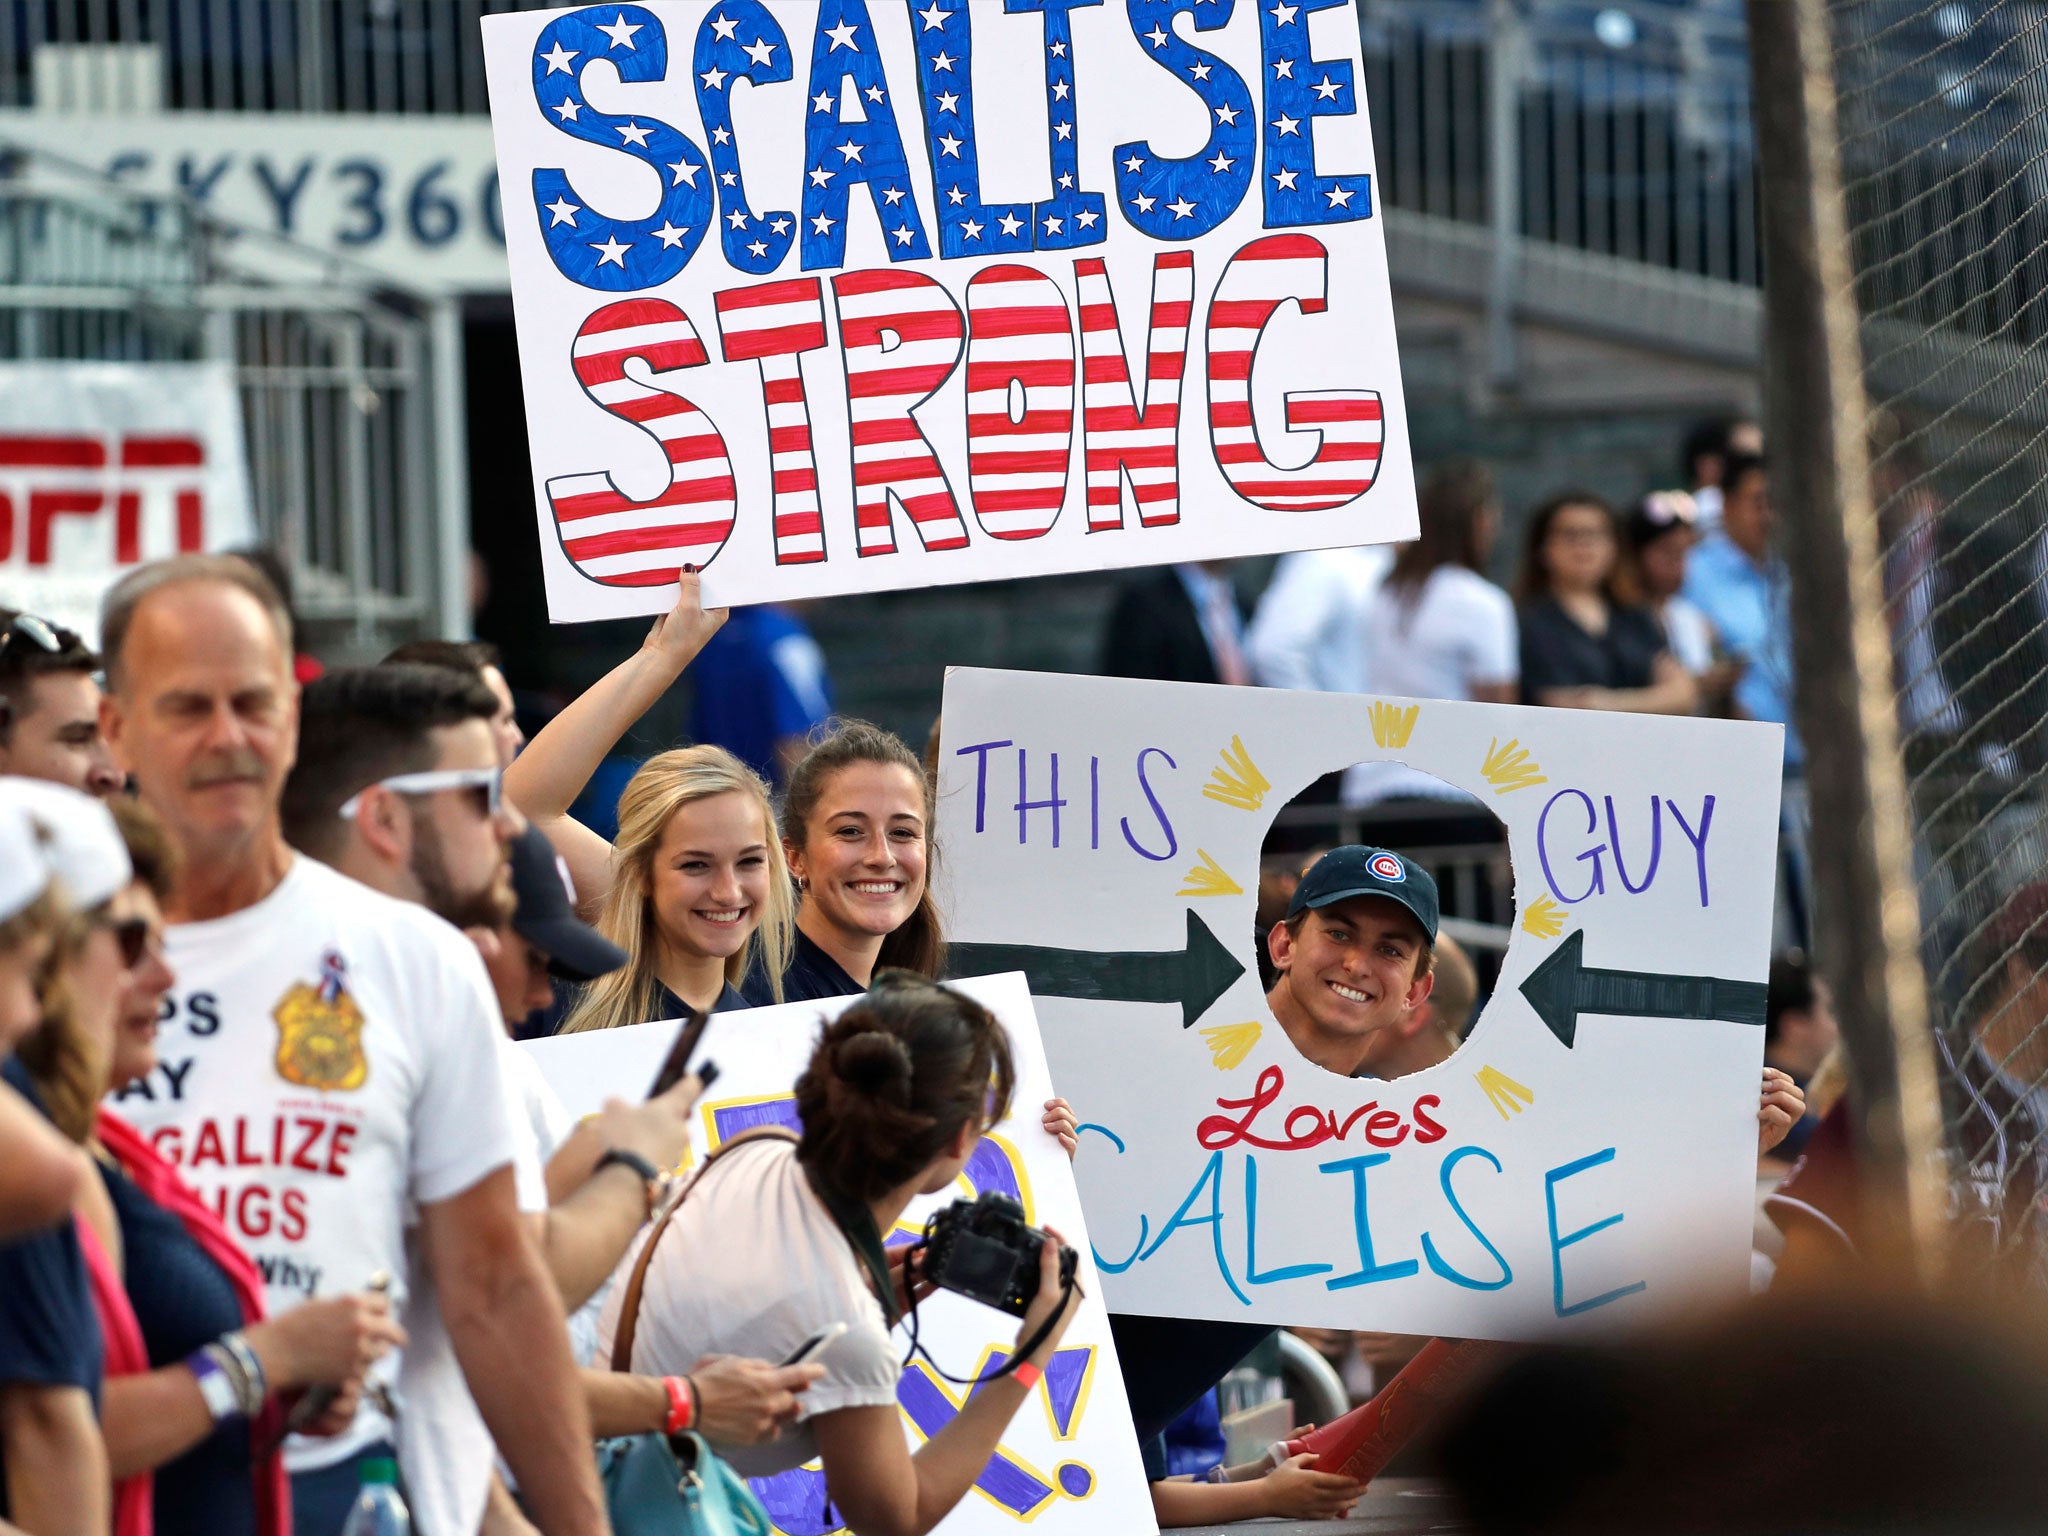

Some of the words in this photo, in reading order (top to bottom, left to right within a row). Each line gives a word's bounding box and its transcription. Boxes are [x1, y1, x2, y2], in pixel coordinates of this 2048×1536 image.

[533, 0, 1372, 291] SCALISE
[546, 232, 1385, 587] STRONG
[0, 434, 205, 564] PN
[957, 740, 1178, 861] THIS
[1536, 788, 1716, 908] GUY
[117, 1057, 193, 1101] AY
[152, 1115, 357, 1177] GALIZE
[1197, 1064, 1448, 1152] Loves
[1076, 1122, 1647, 1318] CALISE
